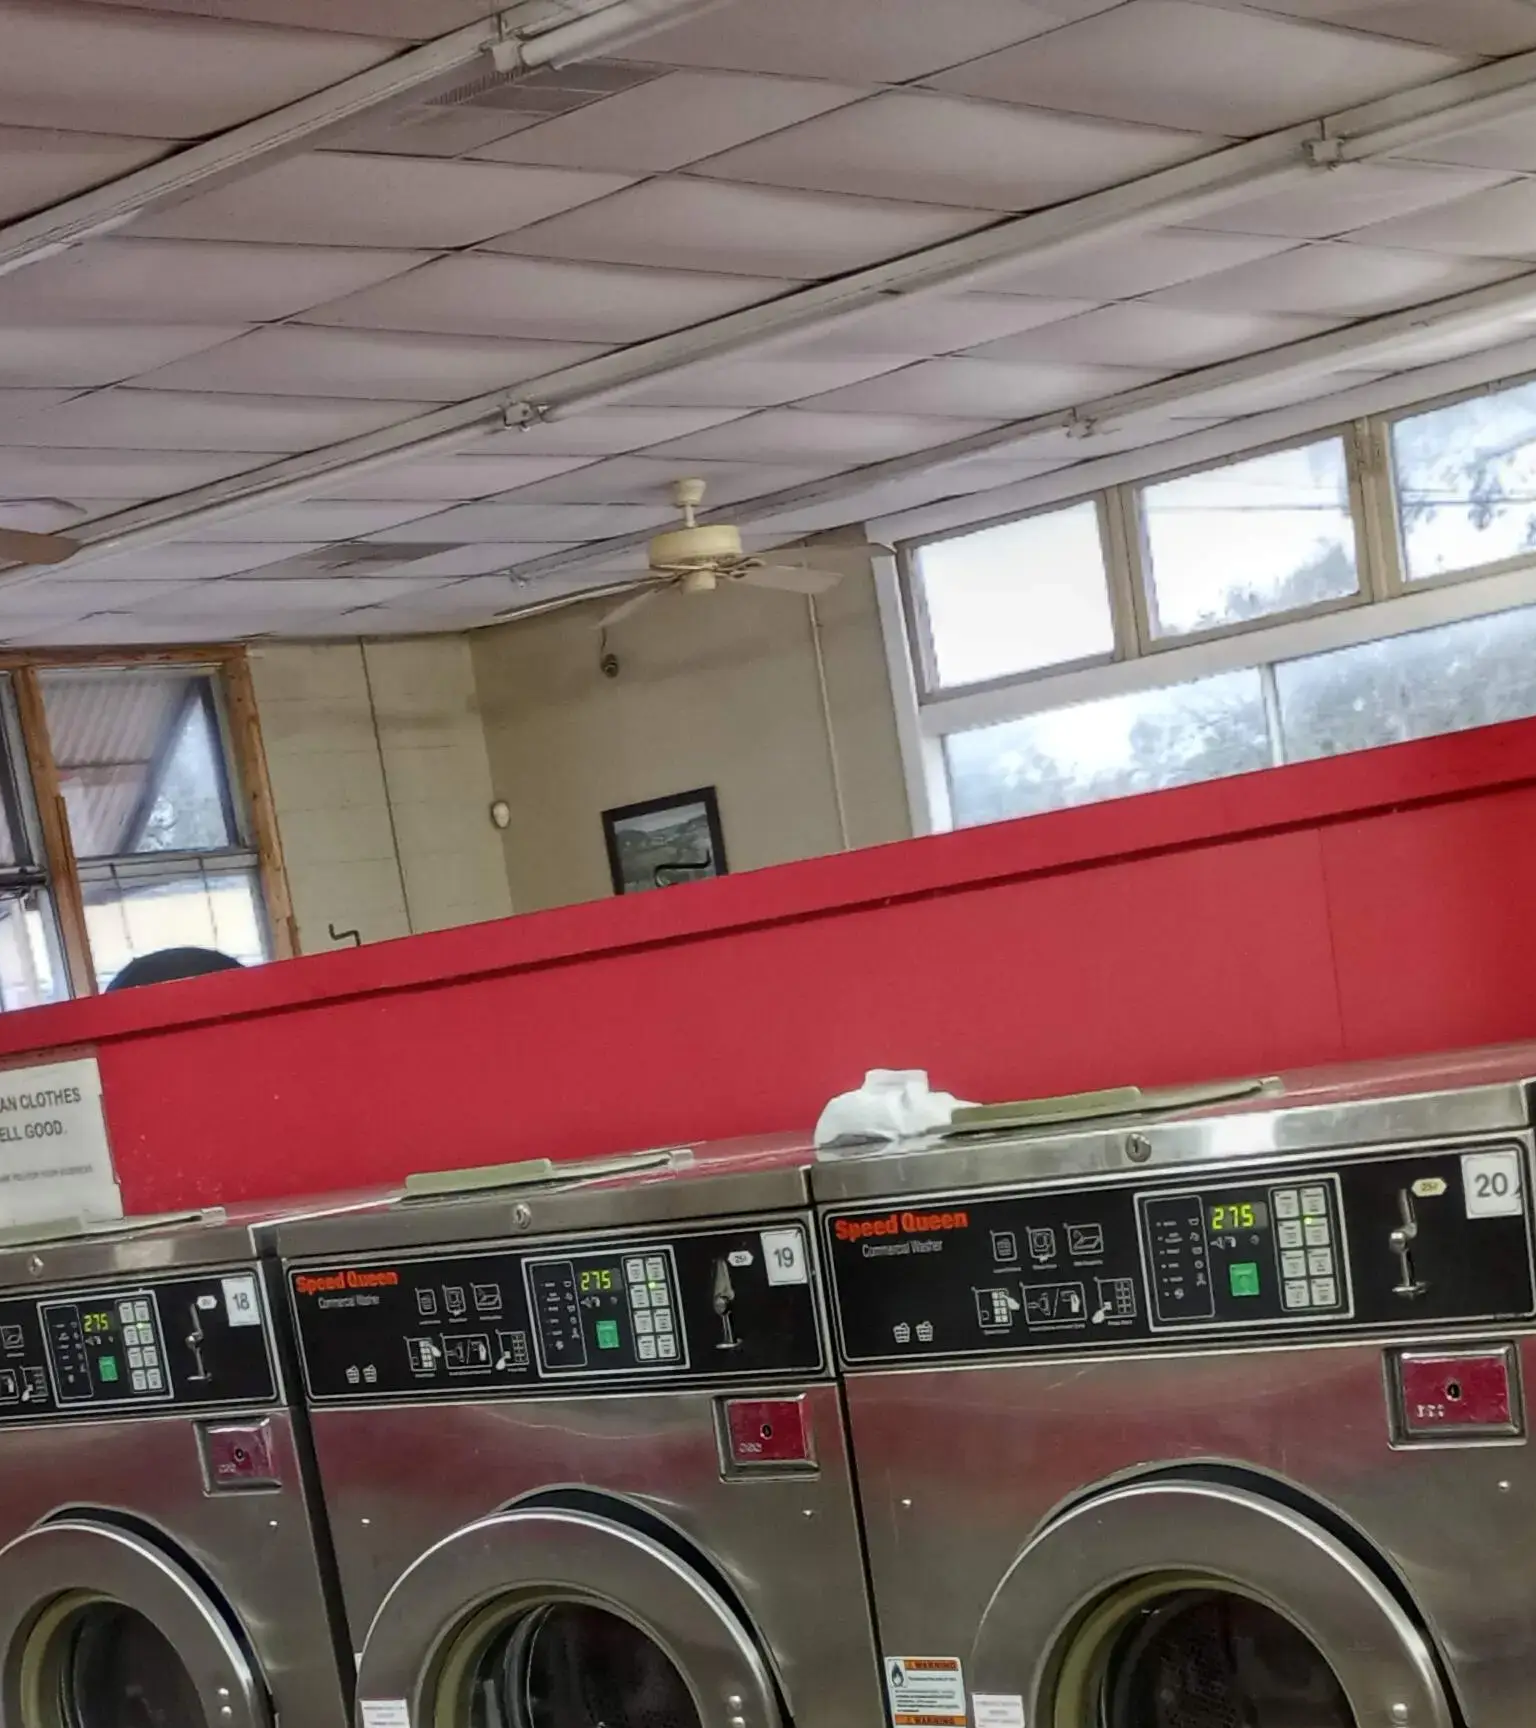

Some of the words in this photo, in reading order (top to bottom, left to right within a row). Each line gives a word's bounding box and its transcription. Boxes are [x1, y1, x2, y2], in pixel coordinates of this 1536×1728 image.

[20, 1087, 82, 1109] CLOTHES
[1475, 1172, 1508, 1198] 20
[835, 1213, 898, 1243] Speed
[902, 1210, 968, 1232] Queen
[1212, 1204, 1255, 1230] 275
[912, 1239, 943, 1253] Washer
[773, 1247, 794, 1269] 19
[296, 1272, 345, 1296] Speed
[347, 1271, 398, 1288] Queen
[580, 1271, 611, 1292] 275
[232, 1293, 250, 1311] 18
[83, 1312, 109, 1332] 275
